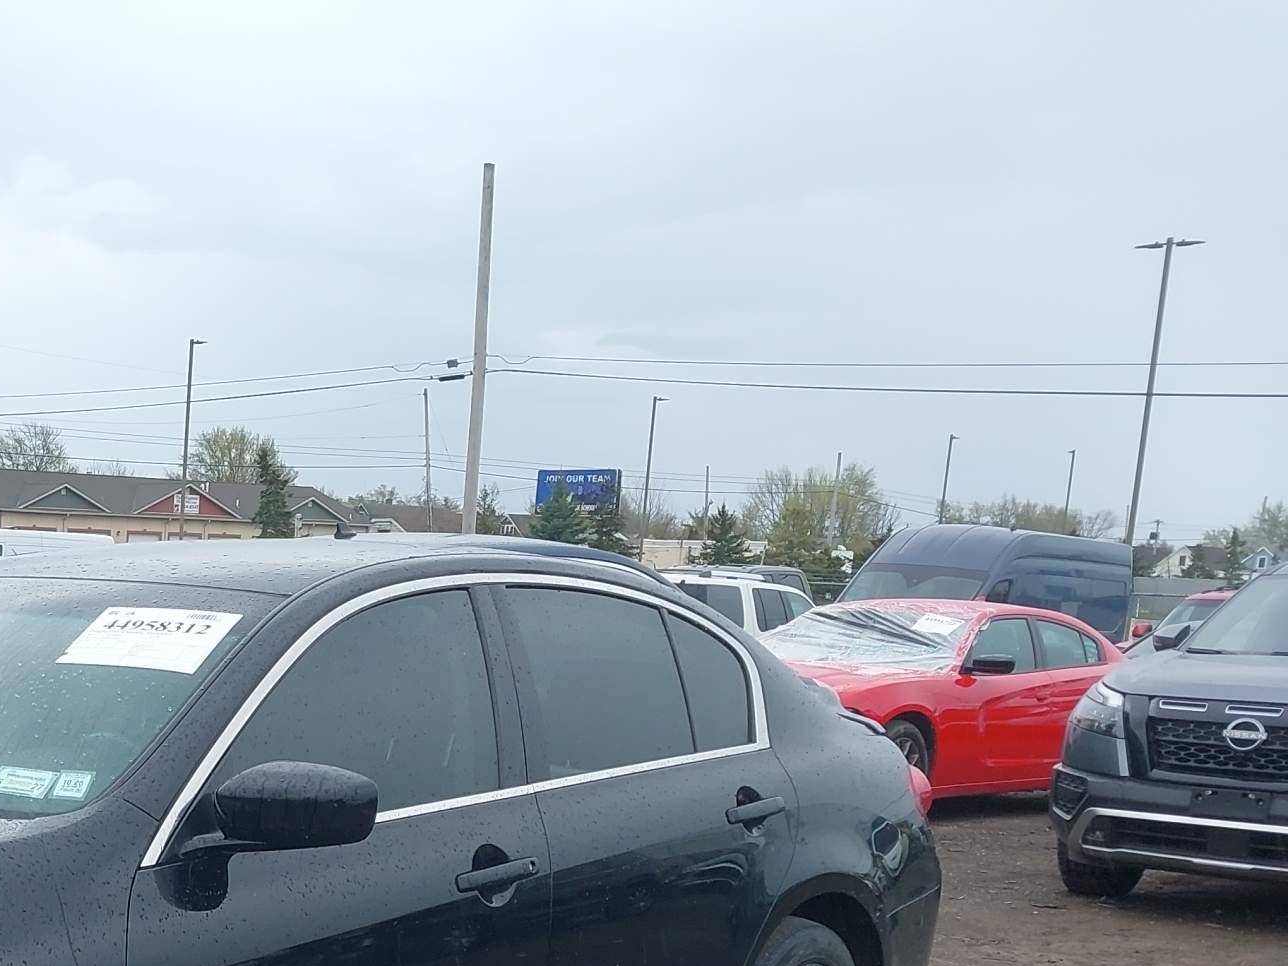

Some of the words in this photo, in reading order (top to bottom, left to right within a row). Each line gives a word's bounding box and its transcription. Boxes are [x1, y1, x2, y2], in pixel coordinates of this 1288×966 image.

[566, 475, 584, 483] OUR
[587, 474, 611, 483] TEAM
[103, 619, 212, 635] 44958312
